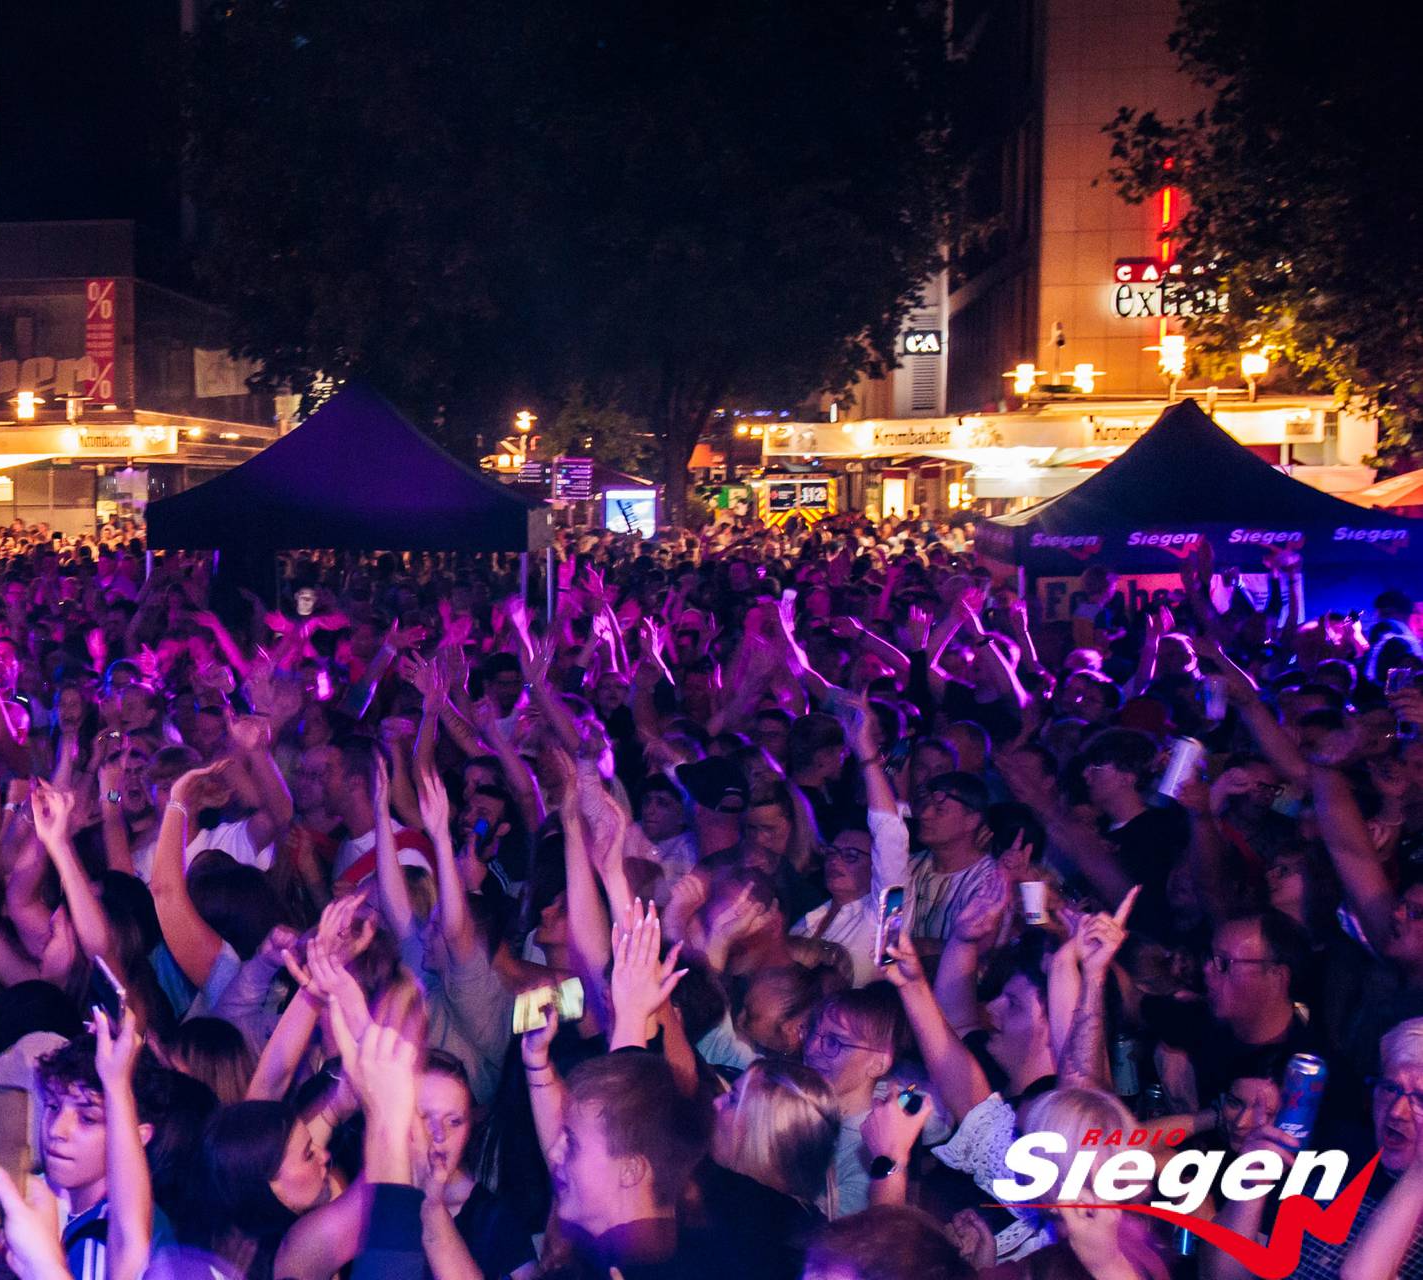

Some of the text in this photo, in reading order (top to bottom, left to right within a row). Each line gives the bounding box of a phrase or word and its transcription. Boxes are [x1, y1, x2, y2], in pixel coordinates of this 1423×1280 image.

[874, 426, 951, 447] Krombacher
[1093, 421, 1151, 441] Kromb
[1031, 532, 1099, 548] Siegen
[1127, 531, 1199, 547] Siegen
[1228, 528, 1304, 545] Siegen
[1333, 526, 1409, 543] Siegen
